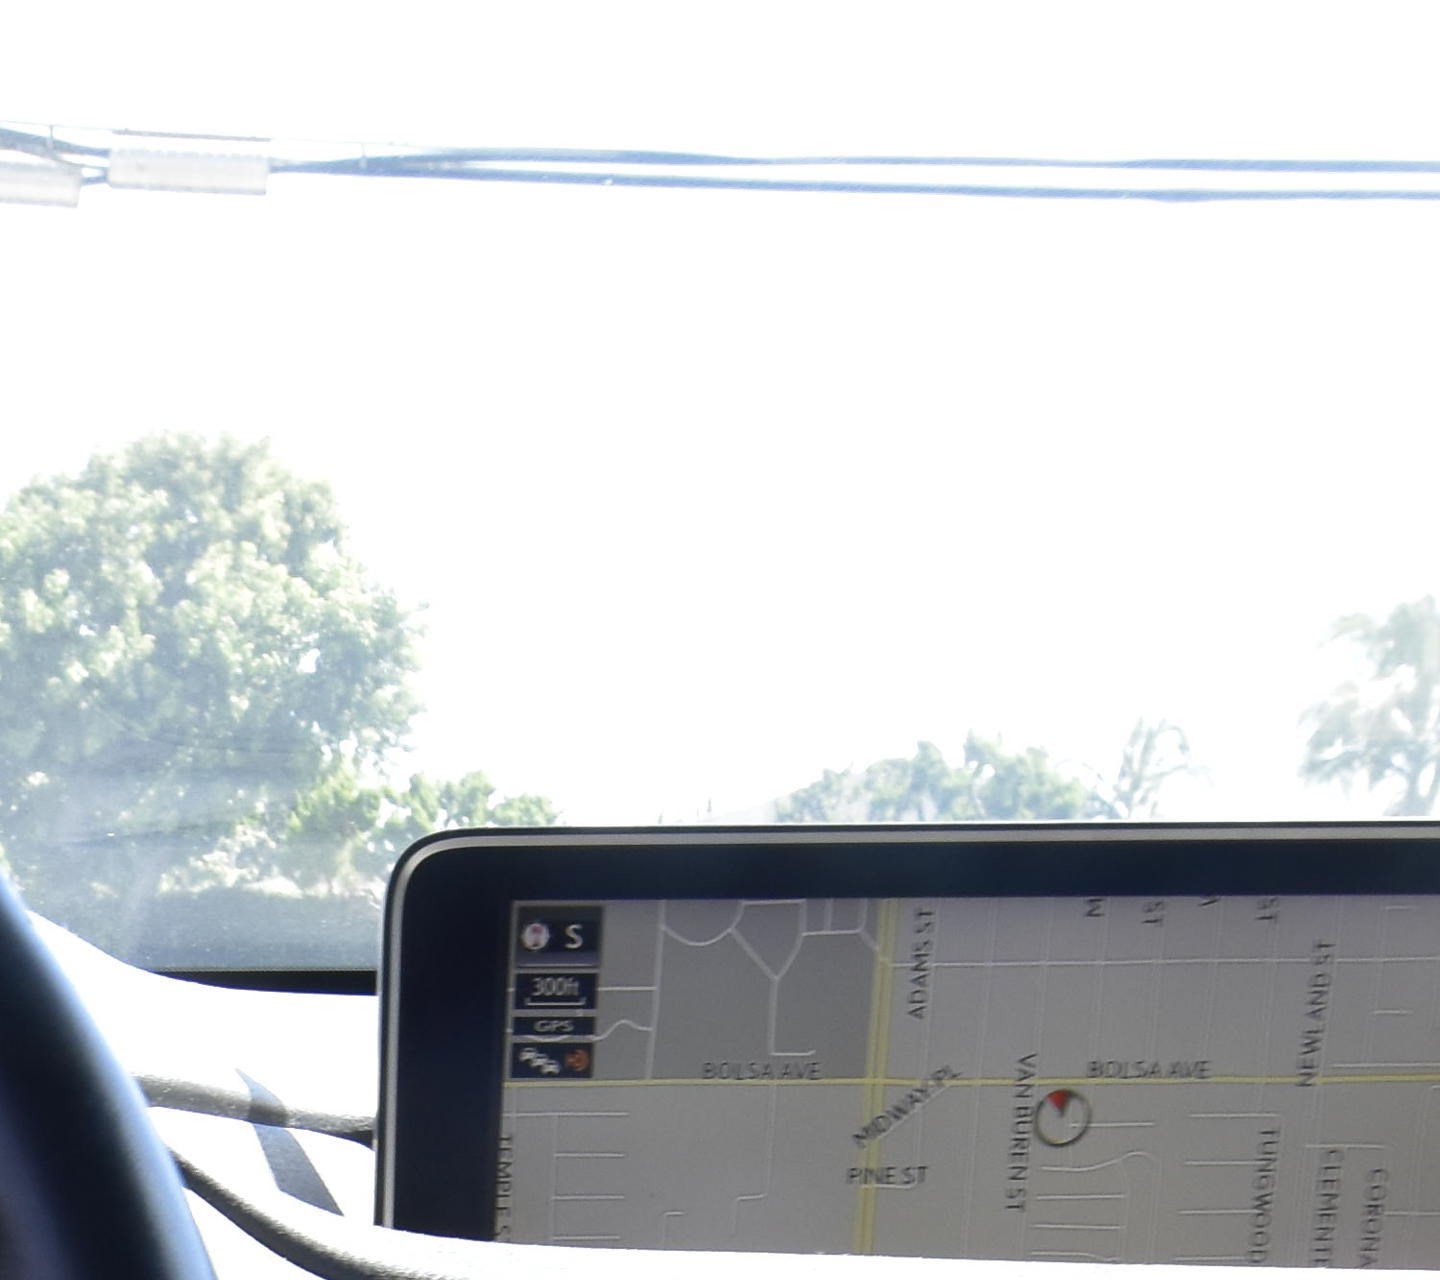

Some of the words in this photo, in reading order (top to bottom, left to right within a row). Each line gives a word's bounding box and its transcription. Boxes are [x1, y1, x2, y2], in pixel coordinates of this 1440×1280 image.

[912, 905, 936, 934] ST
[564, 923, 584, 949] S
[1311, 938, 1338, 966] ST
[531, 976, 580, 999] 300ft
[907, 940, 933, 1020] ADAMS
[533, 1019, 575, 1034] GPS
[1294, 973, 1331, 1087] NEWLAND
[702, 1060, 776, 1080] BOLSA
[778, 1061, 822, 1080] AVE
[1015, 1053, 1038, 1098] VAN
[1087, 1059, 1162, 1080] BOLSA
[1167, 1059, 1212, 1080] AVE
[852, 1087, 930, 1148] MIDWAY
[1007, 1105, 1034, 1181] BUREN
[846, 1166, 896, 1185] PINE
[901, 1166, 929, 1184] ST
[1004, 1188, 1027, 1213] ST
[1248, 1127, 1280, 1263] TUNGWOOD
[1356, 1168, 1389, 1267] CORONA
